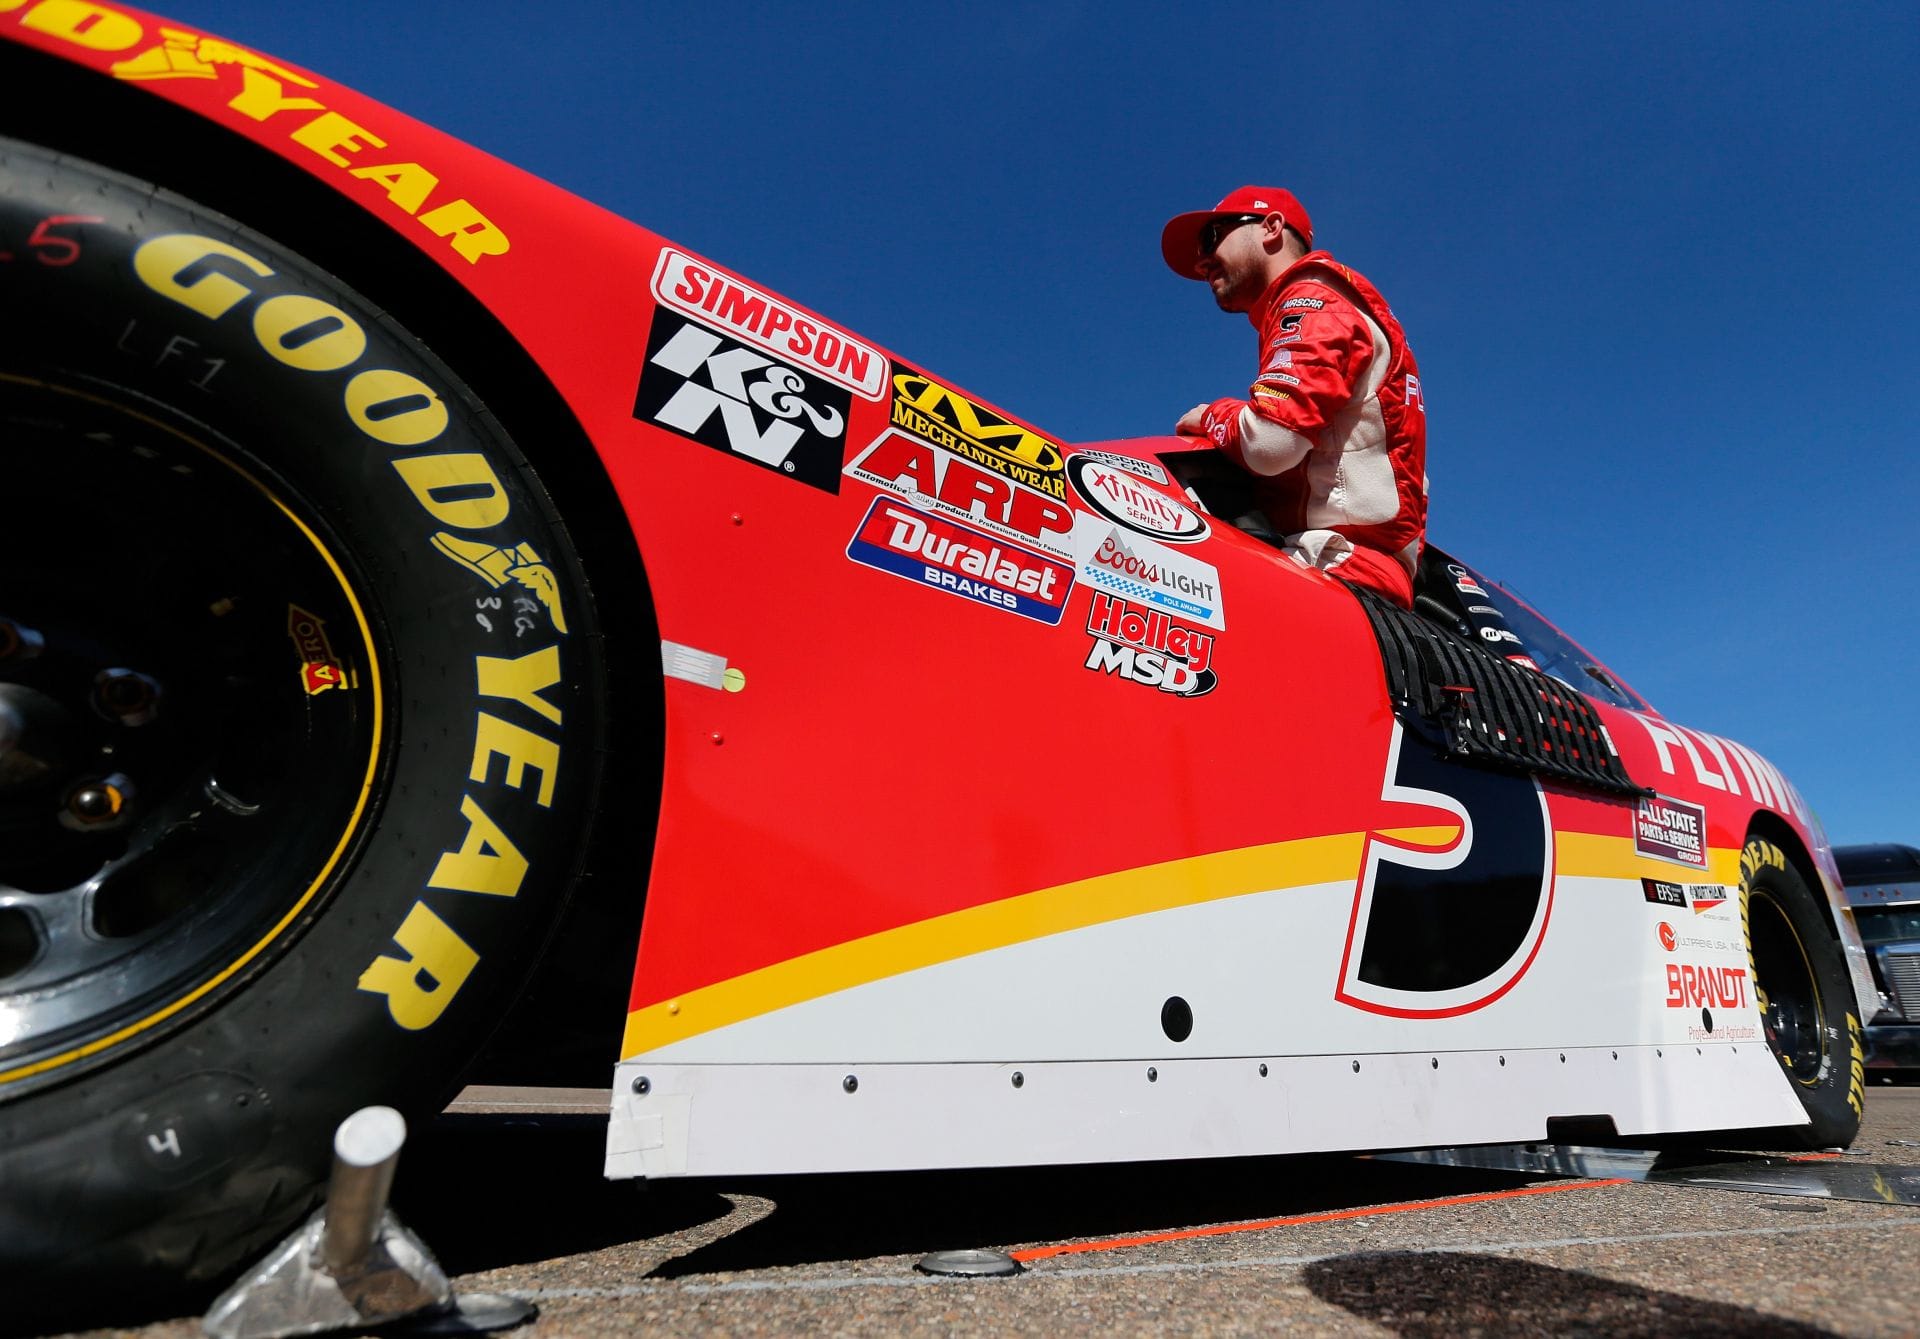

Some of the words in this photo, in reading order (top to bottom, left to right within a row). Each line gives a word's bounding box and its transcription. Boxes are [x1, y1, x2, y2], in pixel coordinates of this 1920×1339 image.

[674, 265, 870, 383] SIMPSON
[1283, 298, 1323, 309] NASCAR
[650, 323, 844, 467] K&N
[892, 399, 1007, 471] MECHANIX
[1009, 464, 1066, 500] WEAR
[857, 433, 1074, 540] ARP
[1090, 467, 1183, 531] xfinity
[853, 469, 907, 494] automotive
[935, 501, 974, 520] products
[978, 518, 1019, 538] Professional
[1020, 534, 1042, 548] Quality
[1043, 543, 1073, 559] Fasteners
[1126, 506, 1163, 530] SERIES
[885, 507, 1056, 601] Duralast
[1094, 537, 1160, 583] Coors
[1161, 568, 1213, 602] LIGHT
[924, 565, 1018, 609] BRAKES
[1163, 596, 1179, 607] POLE
[1088, 593, 1215, 671] Holley
[1085, 640, 1199, 693] MSD
[1638, 799, 1697, 834] ALLSTATE
[1639, 821, 1663, 842] PARTS
[1669, 829, 1700, 850] SERVICE
[1677, 850, 1702, 863] GROUP
[1655, 883, 1673, 902] EFS
[1666, 963, 1746, 1008] BRANDT
[1726, 1025, 1755, 1041] Agriculture
[149, 1128, 180, 1157] 4
